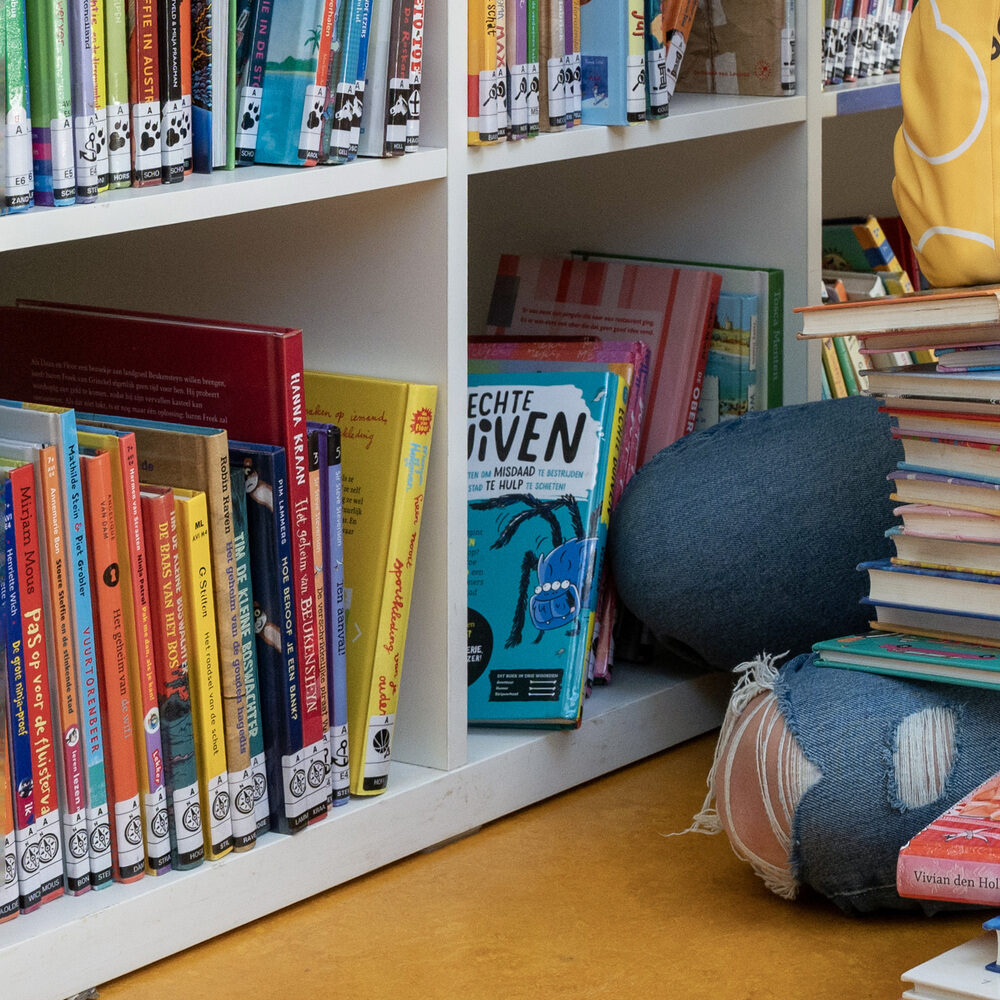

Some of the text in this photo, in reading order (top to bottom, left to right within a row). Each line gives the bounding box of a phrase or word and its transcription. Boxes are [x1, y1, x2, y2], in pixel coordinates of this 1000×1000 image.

[258, 23, 268, 36] IN
[143, 33, 153, 51] IN
[255, 40, 266, 60] DE
[290, 372, 306, 486] HANNA KRAAN
[493, 465, 536, 478] MISDAAD
[546, 470, 584, 478] BESTRIJDEN
[219, 456, 232, 534] Robin Raven
[486, 480, 524, 491] TE HULP
[67, 444, 86, 597] Mathilde Stein Piet Grobler
[194, 520, 205, 530] ML
[20, 486, 36, 595] Mirjam Mous
[158, 522, 179, 669] DE BAAS VAN HET BOS
[29, 651, 40, 670] op
[282, 587, 298, 721] BEROOF BANK?
[32, 674, 45, 710] voor
[83, 626, 101, 754] VUURTORENBEER
[35, 716, 47, 737] de
[913, 869, 951, 886] Vivian
[953, 873, 976, 887] den
